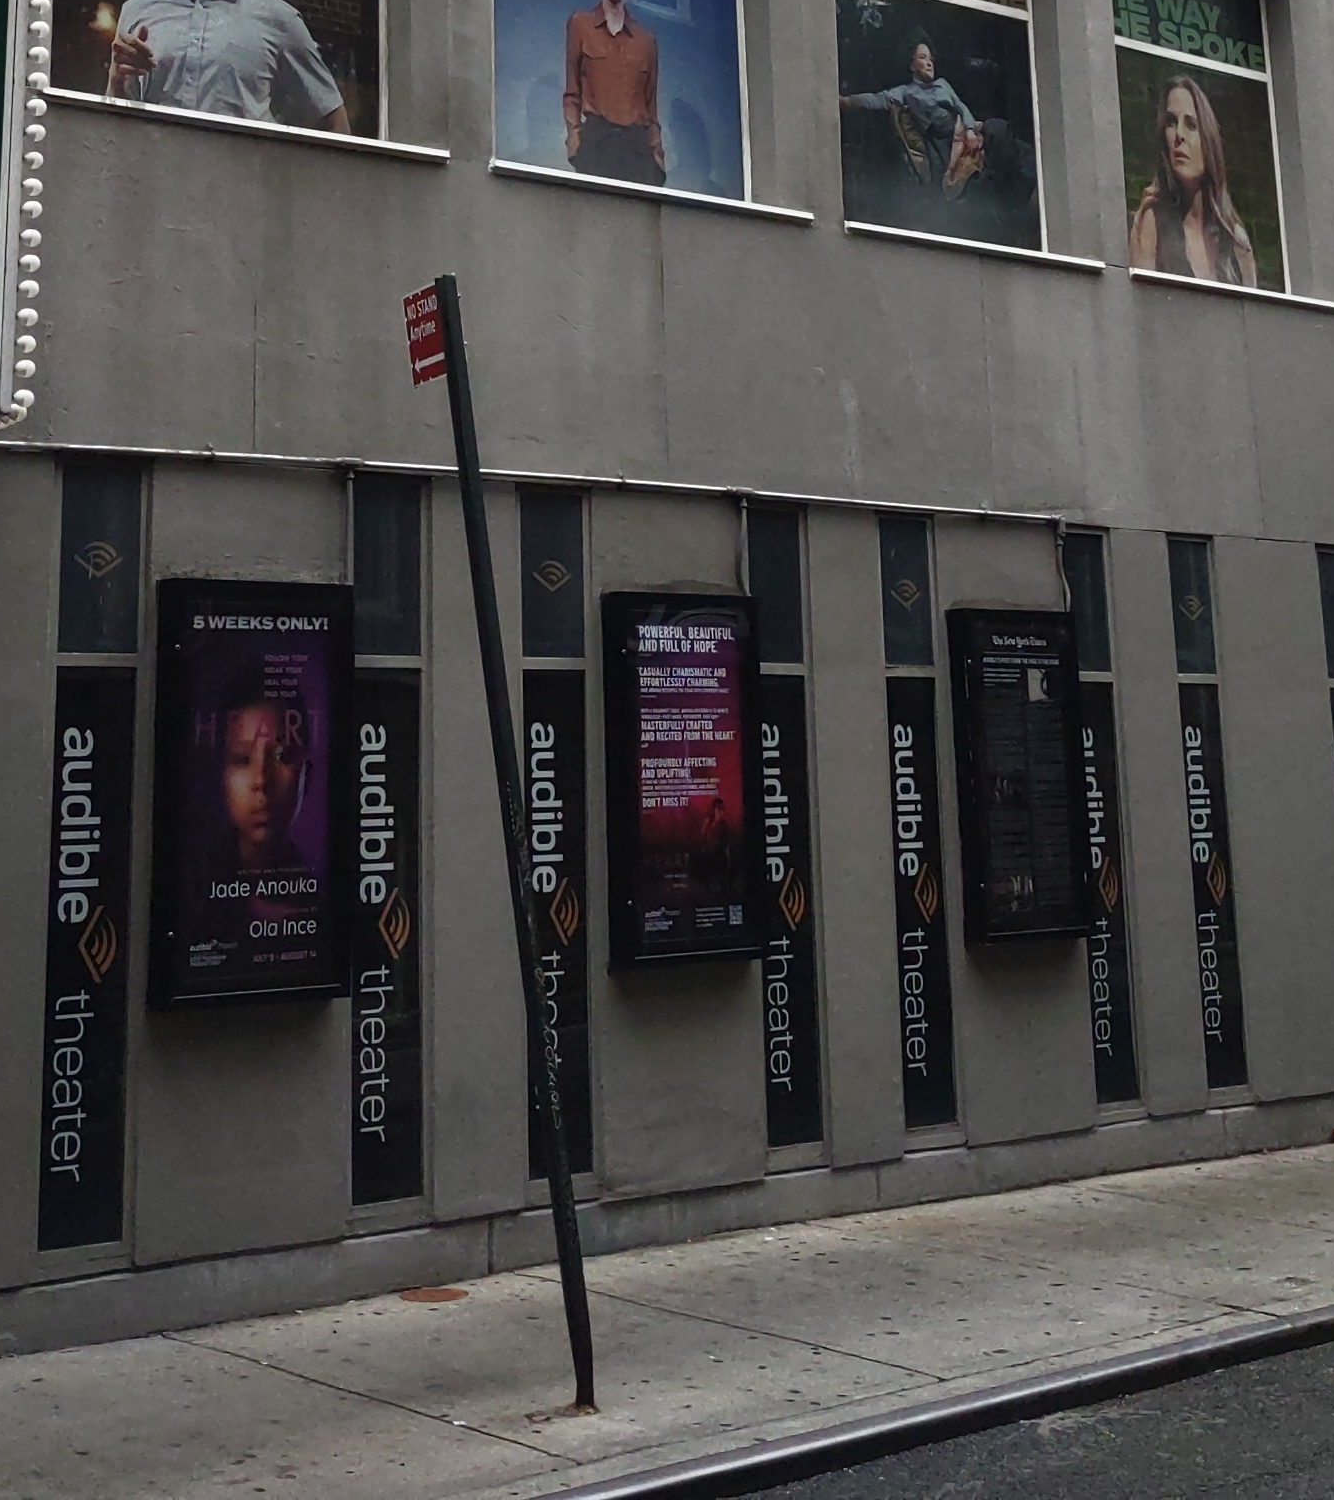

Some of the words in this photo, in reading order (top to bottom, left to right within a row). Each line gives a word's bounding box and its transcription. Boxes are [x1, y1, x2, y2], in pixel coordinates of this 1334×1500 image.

[1158, 20, 1266, 72] SPOKE
[410, 320, 437, 343] Anytime
[192, 615, 205, 630] 5
[208, 615, 273, 630] WEEKS
[276, 615, 330, 631] ONLY!
[638, 639, 658, 653] AND
[660, 640, 680, 653] FULL
[681, 640, 692, 653] OF
[640, 677, 686, 687] EFFORTLESSLY
[192, 707, 325, 748] HEART
[702, 731, 714, 740] THE
[1185, 726, 1210, 864] audible
[56, 727, 102, 925] audible
[359, 723, 395, 905] audible
[530, 722, 565, 894] audible
[761, 723, 791, 884] audible
[893, 724, 922, 877] audible
[209, 879, 251, 900] Jade
[255, 876, 318, 897] Anouka
[249, 920, 278, 939] Ola
[282, 918, 318, 937] Ince
[767, 933, 793, 1092] theater
[903, 928, 927, 1077] theater
[1088, 917, 1113, 1058] theater
[1197, 908, 1222, 1043] theater
[50, 989, 95, 1182] theater
[359, 964, 394, 1143] theater
